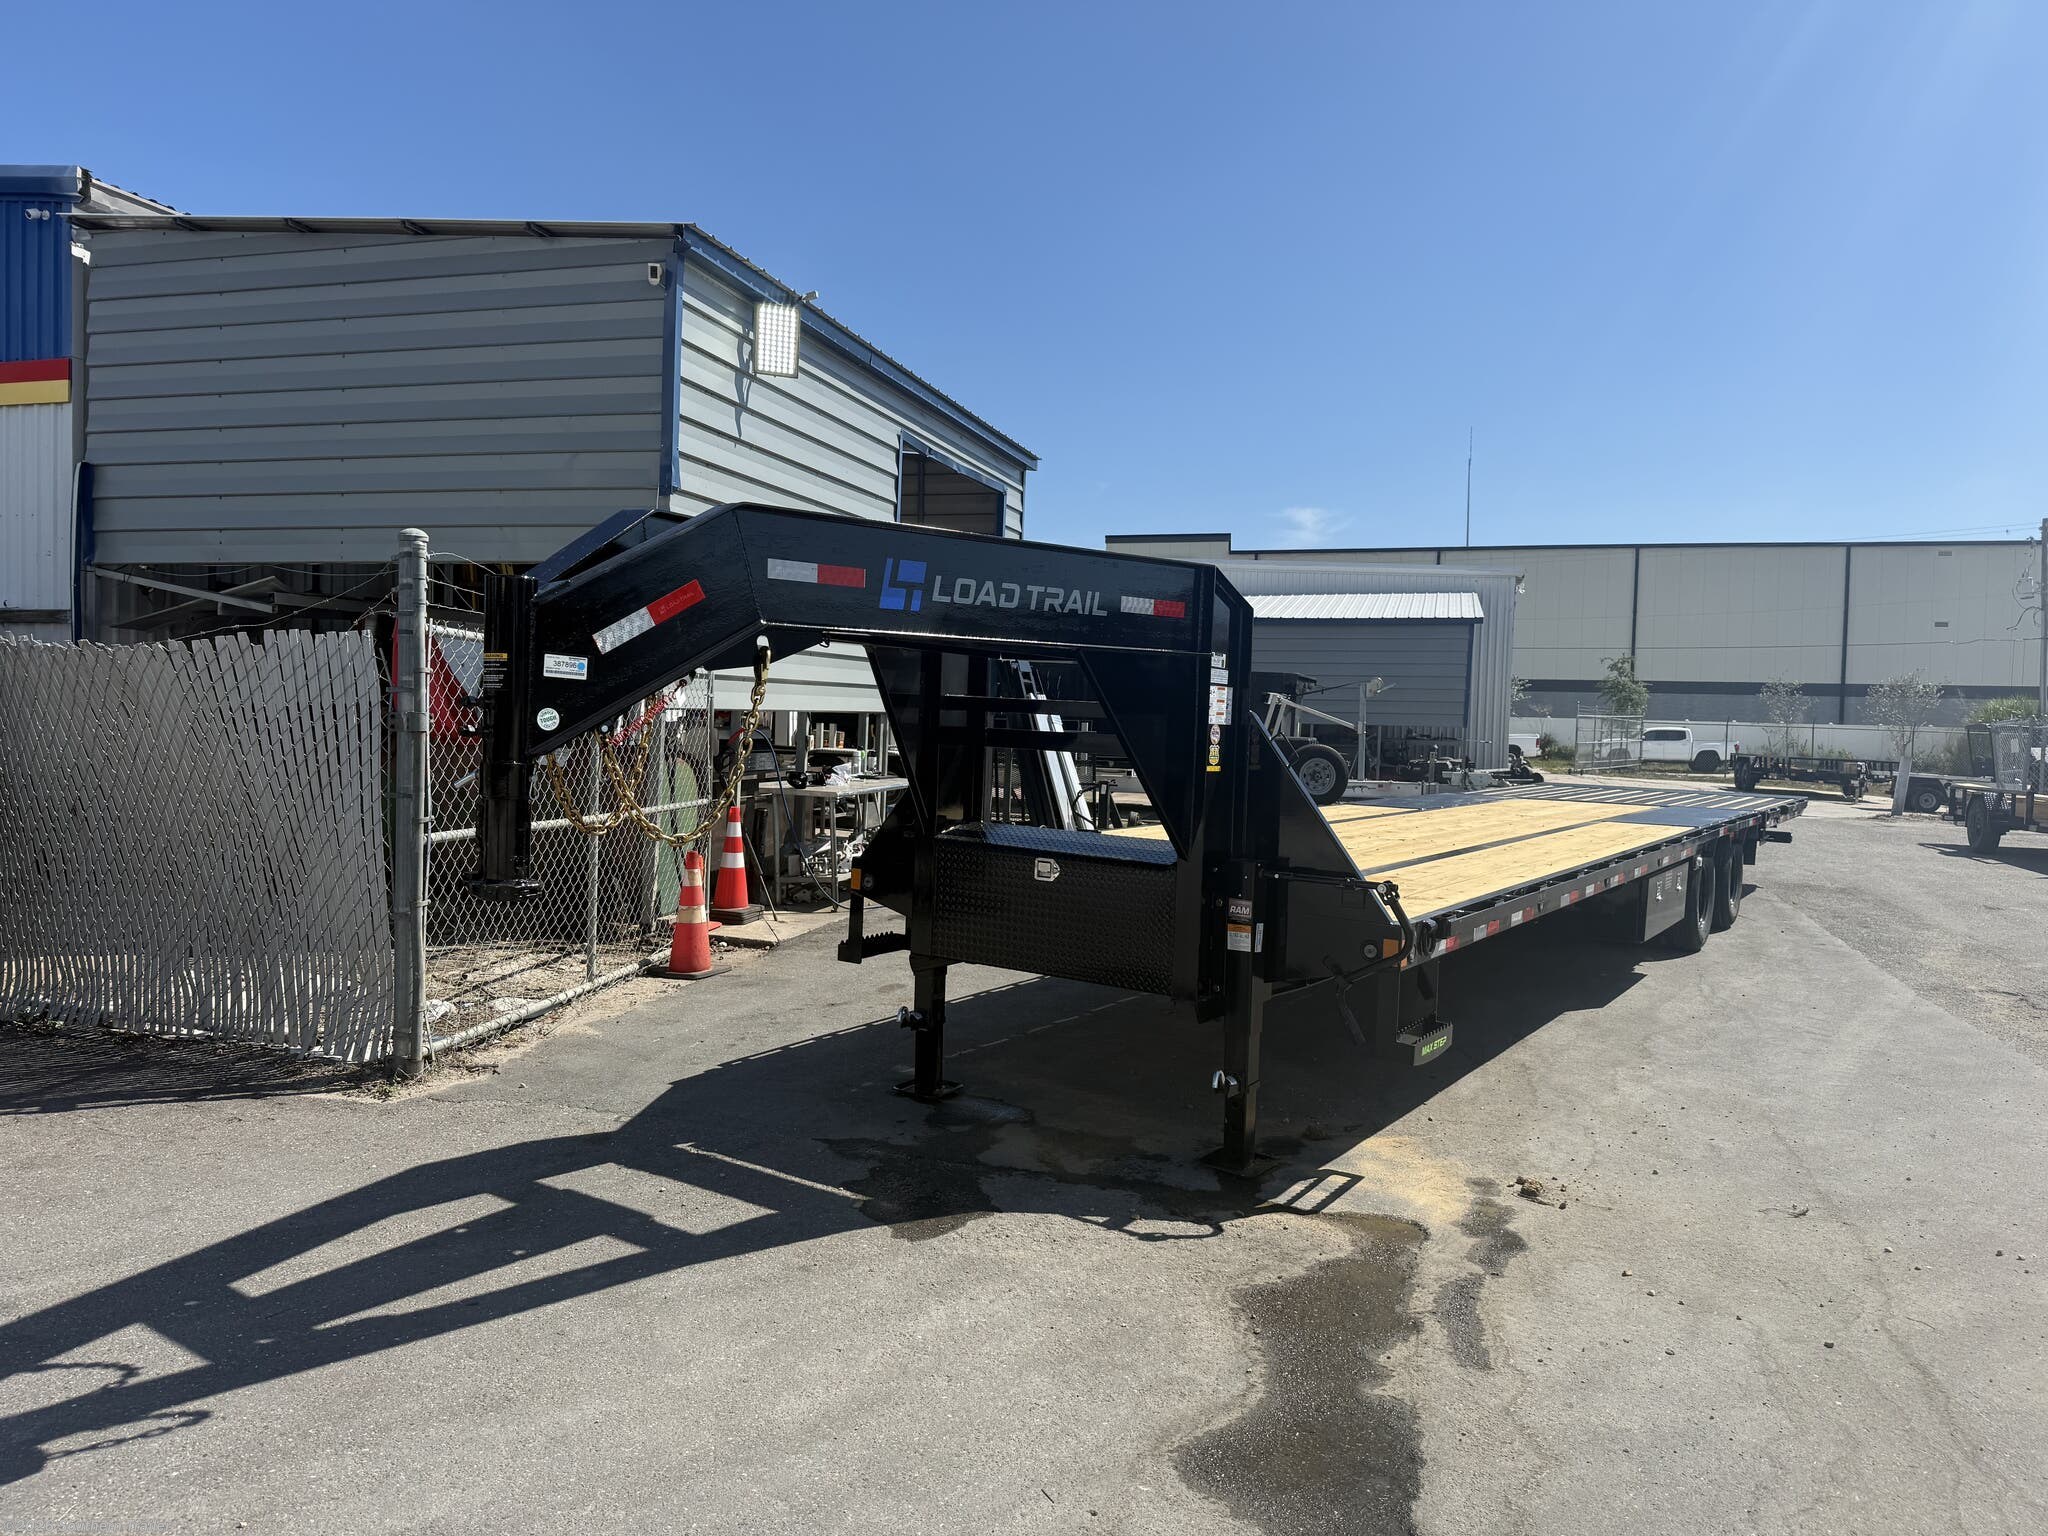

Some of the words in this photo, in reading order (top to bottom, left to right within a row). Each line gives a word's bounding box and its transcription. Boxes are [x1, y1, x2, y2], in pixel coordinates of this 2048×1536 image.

[932, 575, 1021, 609] LOAD
[1027, 585, 1108, 617] TRAIL
[553, 660, 577, 669] 387896
[1229, 905, 1250, 915] RAM
[1421, 1042, 1434, 1056] MAX
[1433, 1036, 1447, 1050] STEP
